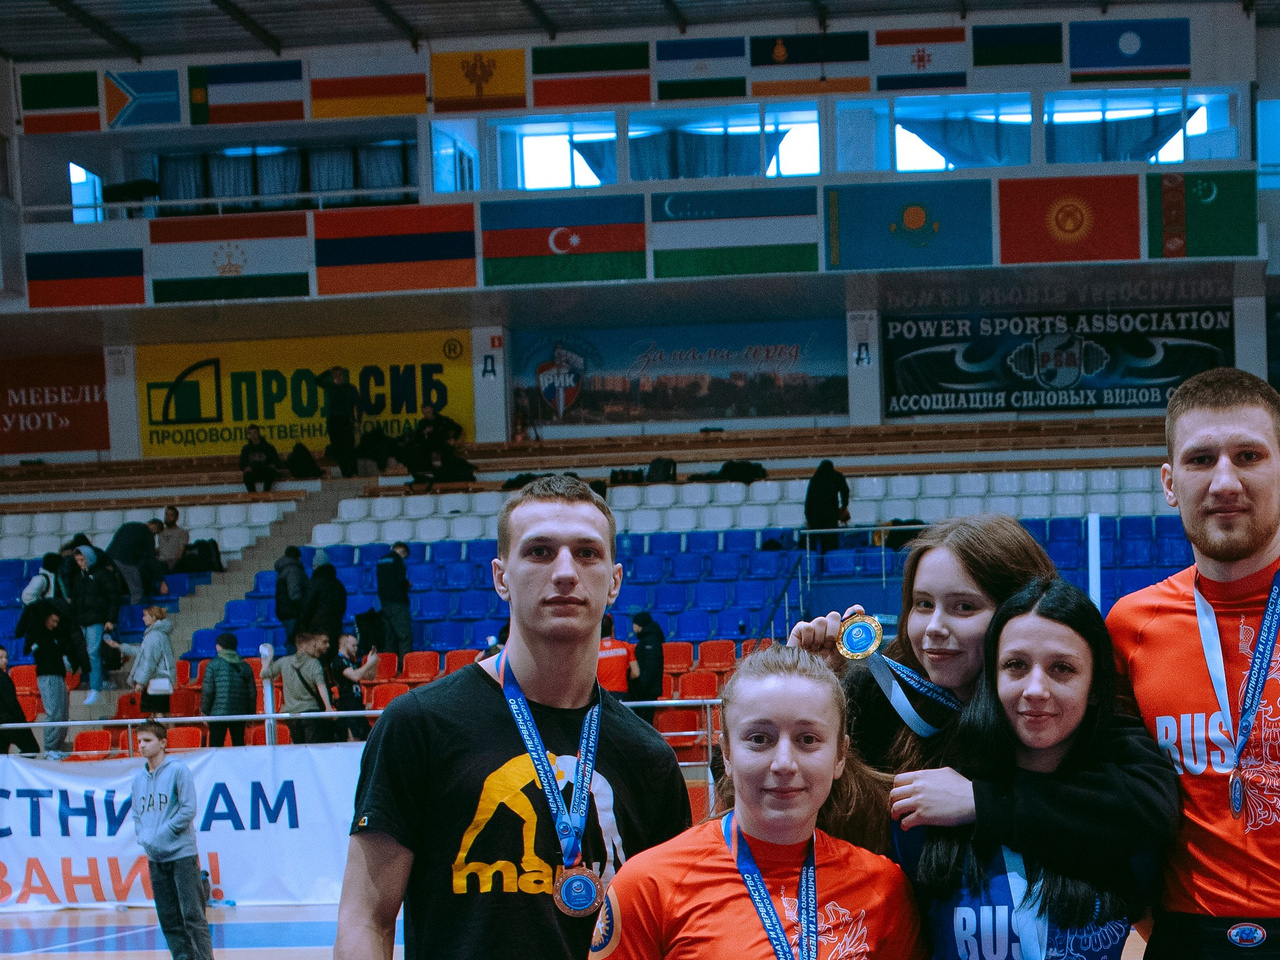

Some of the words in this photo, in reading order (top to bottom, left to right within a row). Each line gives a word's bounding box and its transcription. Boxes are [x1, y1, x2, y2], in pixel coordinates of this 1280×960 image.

[887, 319, 971, 339] POWER
[979, 316, 1067, 336] SPORTS
[1076, 311, 1231, 333] ASSOCIATION
[231, 363, 448, 421] ПРОСИБ
[889, 391, 1006, 412] АССОЦИАЦИЯ
[1010, 389, 1096, 408] СИЛОВЫХ
[1103, 387, 1161, 405] ВИДОВ
[1243, 651, 1263, 709] ЧЕМПИОНАТ
[1259, 584, 1279, 643] ПЕРВЕНСТВО
[508, 696, 535, 750] ПЕРВЕНСТВО
[1156, 710, 1238, 775] RUS
[533, 760, 559, 814] ЧЕМПИОНАТ
[578, 761, 592, 817] ПЕРВЕНСТВО
[743, 871, 773, 931] ПЕРВЕНСТВО
[807, 866, 815, 922] ЧЕМПИОНАТ
